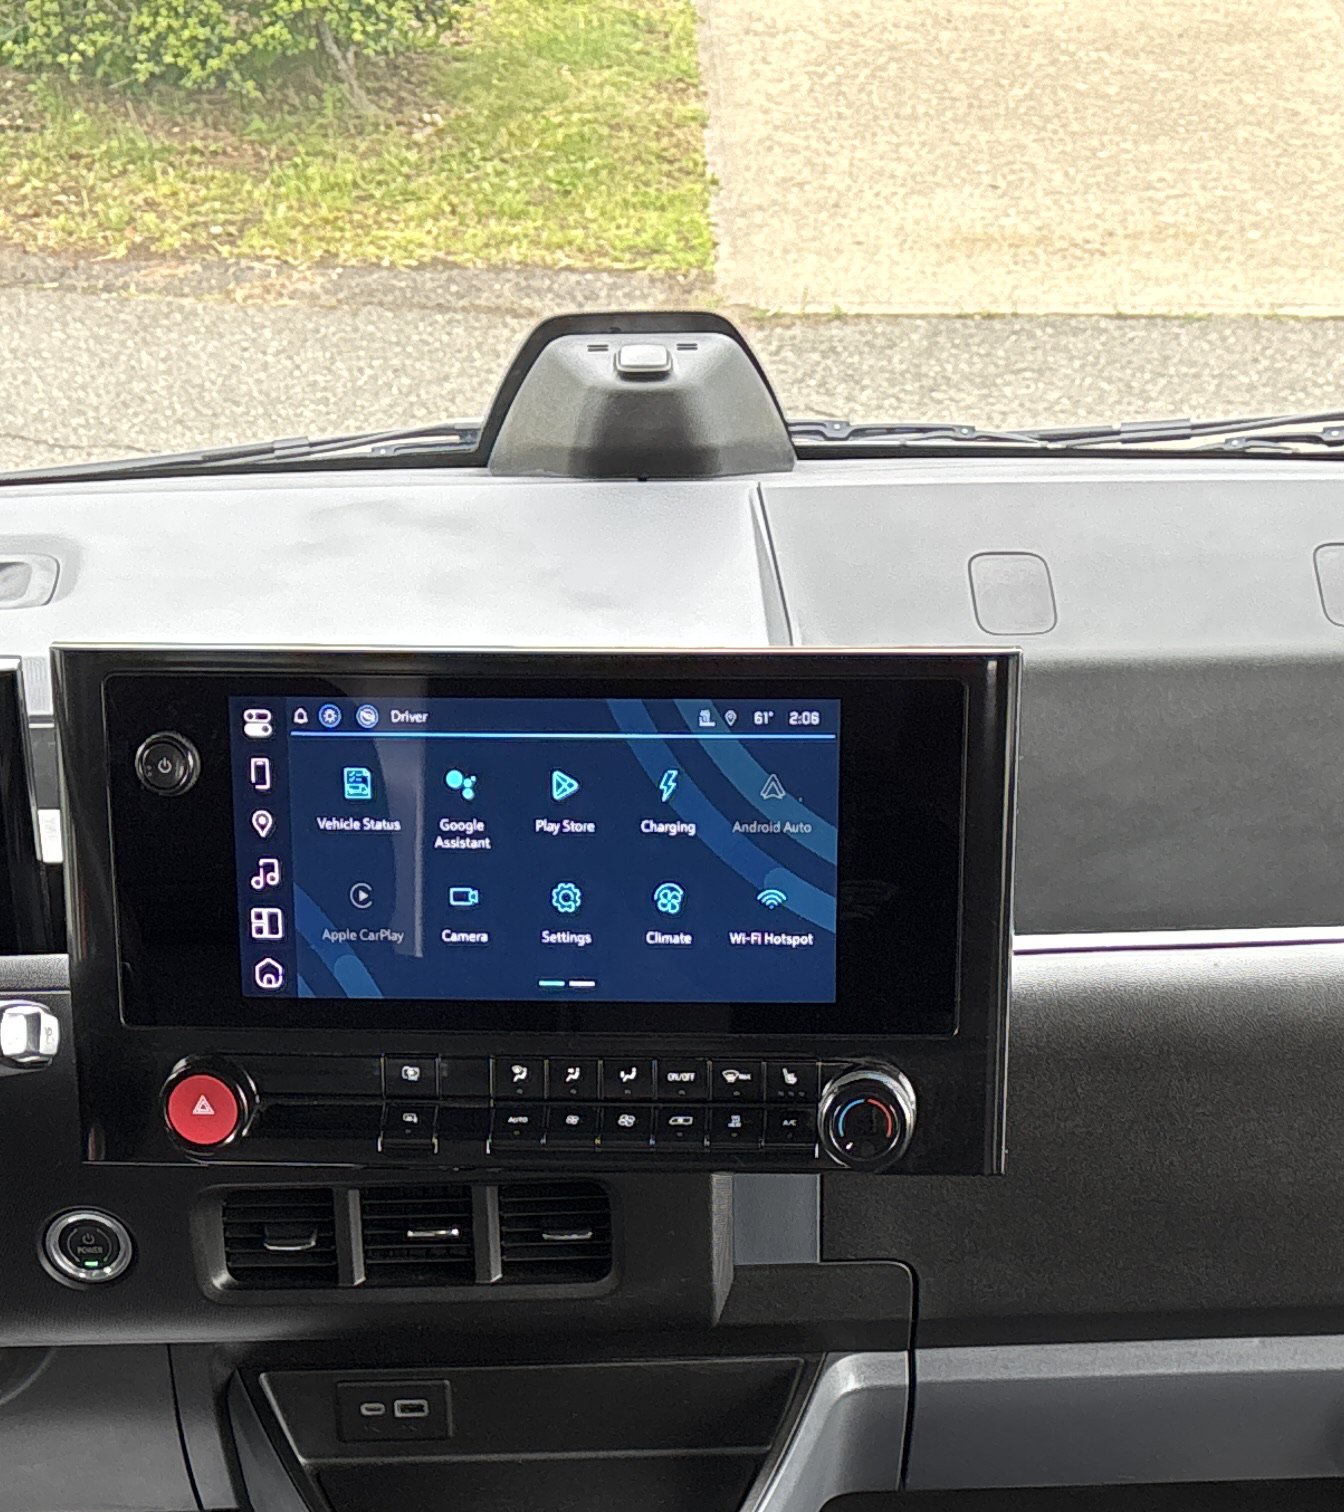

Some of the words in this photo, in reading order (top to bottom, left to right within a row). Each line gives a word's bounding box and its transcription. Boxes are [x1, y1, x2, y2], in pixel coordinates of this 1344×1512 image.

[390, 709, 429, 724] Driver
[788, 710, 821, 726] 2:06
[317, 817, 362, 832] Vehicle
[364, 817, 402, 832] Status
[439, 818, 485, 835] Google
[535, 818, 560, 835] Play
[563, 819, 596, 834] Store
[640, 819, 696, 837] Charging
[732, 820, 782, 834] Android
[784, 820, 813, 834] Auto
[434, 836, 492, 850] Assistant
[322, 928, 357, 944] Apple
[359, 928, 404, 944] CarPlay
[441, 929, 489, 944] Camera
[541, 929, 592, 947] Settings
[646, 930, 693, 946] Climate
[730, 931, 762, 946] Wi-Fi
[763, 931, 814, 948] Hotspot
[667, 1072, 696, 1082] ON/OFF
[507, 1116, 529, 1124] AUTO
[782, 1119, 798, 1127] A/C
[76, 1245, 104, 1255] POWER
